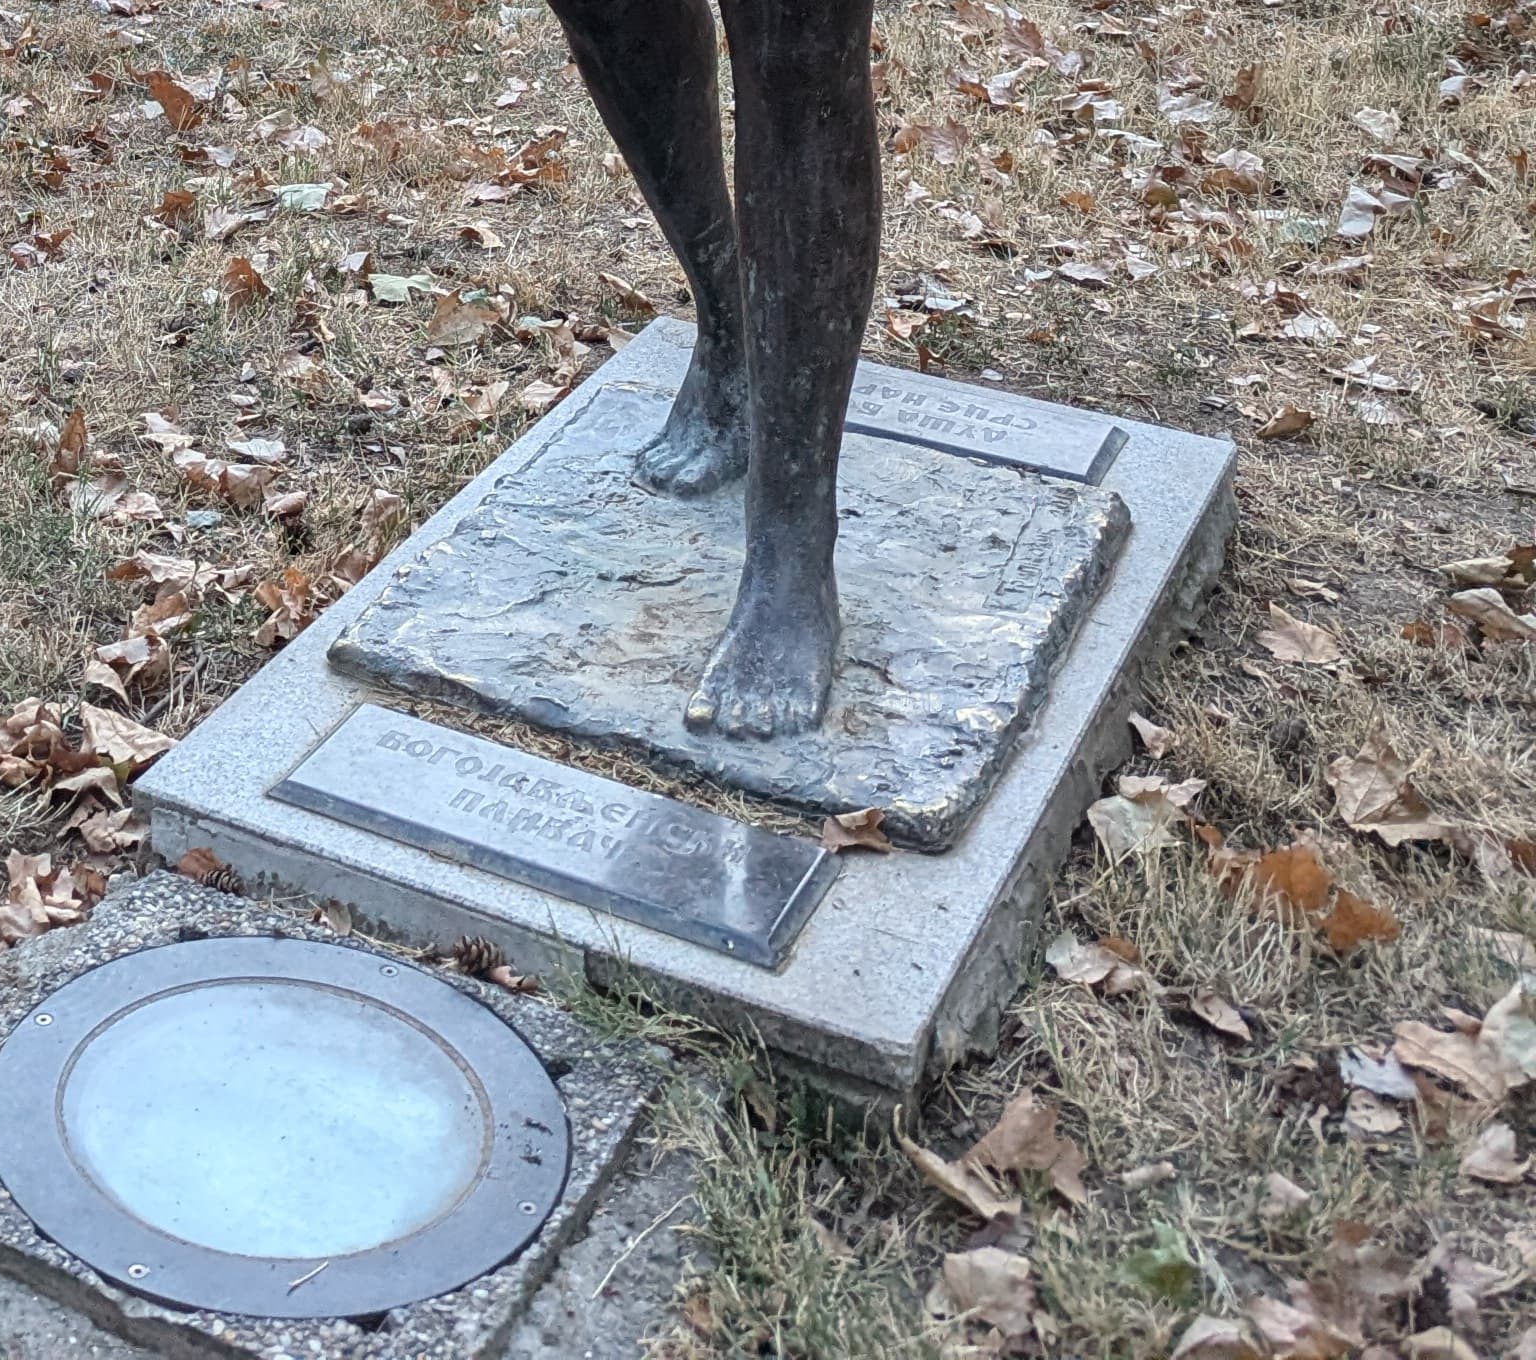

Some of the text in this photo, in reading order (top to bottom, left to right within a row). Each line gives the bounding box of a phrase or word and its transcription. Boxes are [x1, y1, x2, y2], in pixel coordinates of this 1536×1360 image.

[897, 409, 1008, 443] ДУША
[937, 400, 1039, 430] СРЦЕ
[374, 729, 752, 865] БОГОЈАВЉЕНСКИ
[447, 787, 627, 860] ПЛИВАЧ
